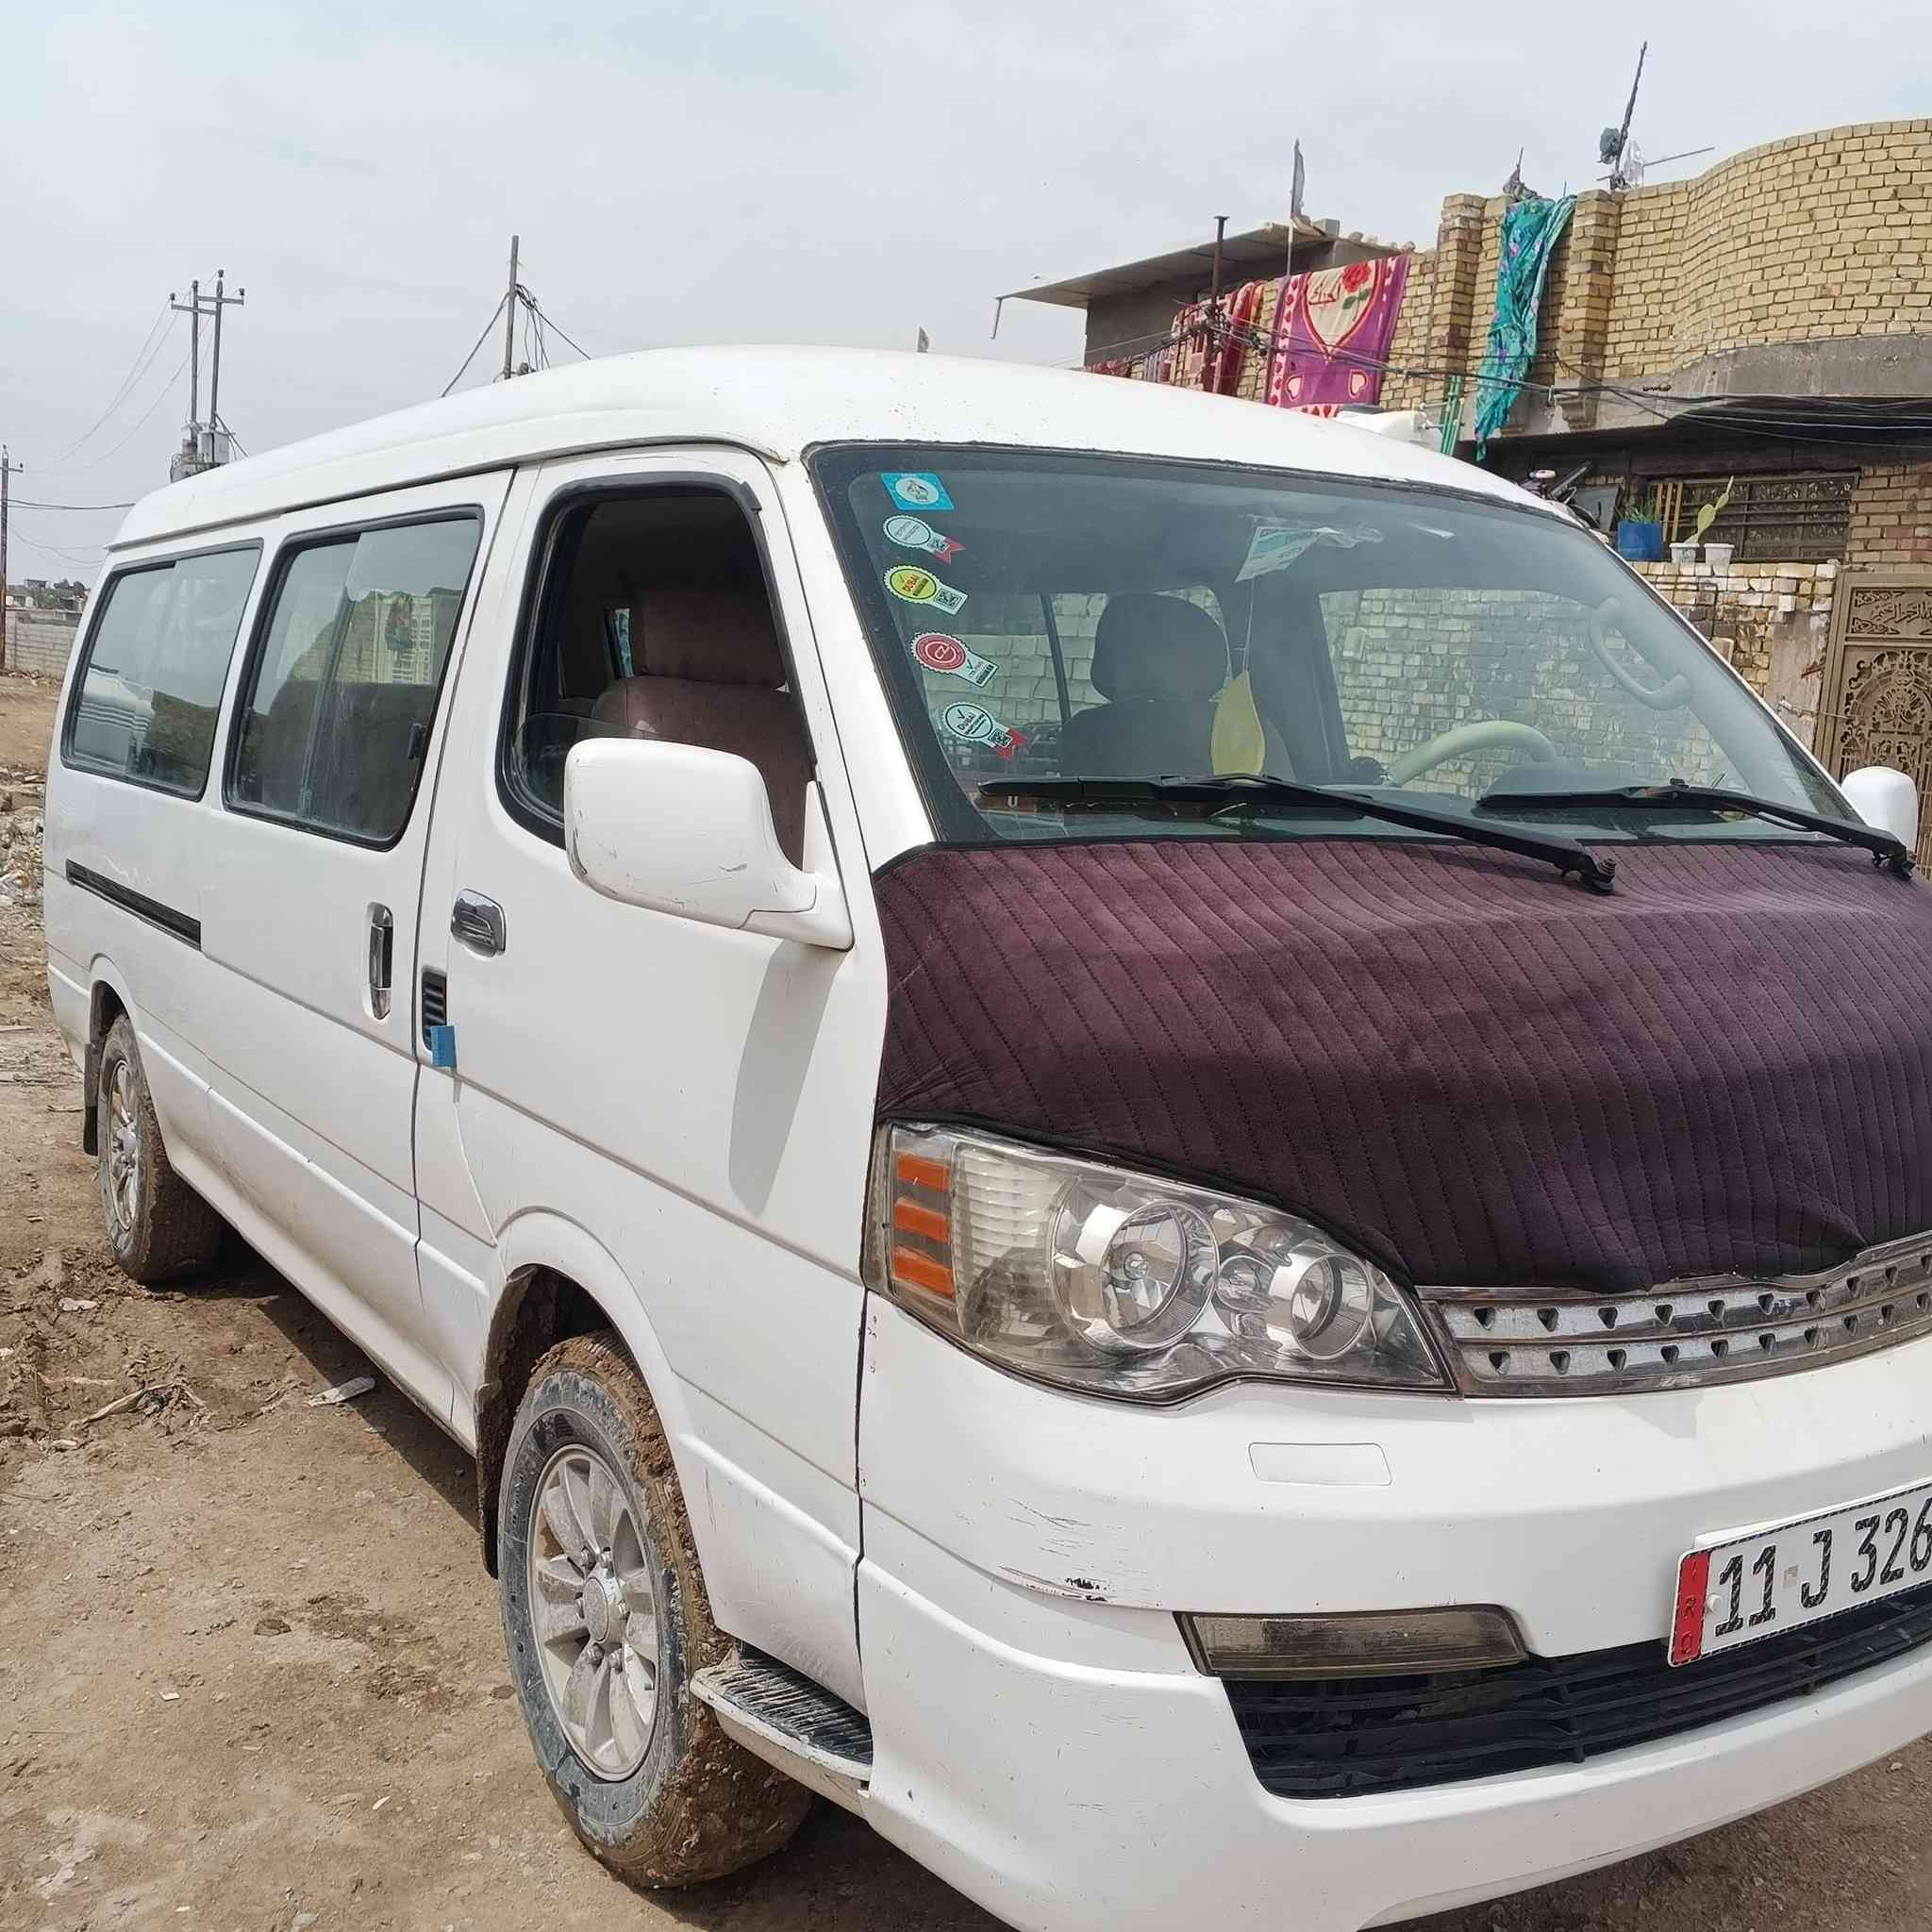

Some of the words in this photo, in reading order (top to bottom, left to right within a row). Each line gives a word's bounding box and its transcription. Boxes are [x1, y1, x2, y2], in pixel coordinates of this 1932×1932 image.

[1715, 1544, 1776, 1637] 11
[1801, 1529, 1832, 1608] J
[1851, 1497, 1932, 1592] 326
